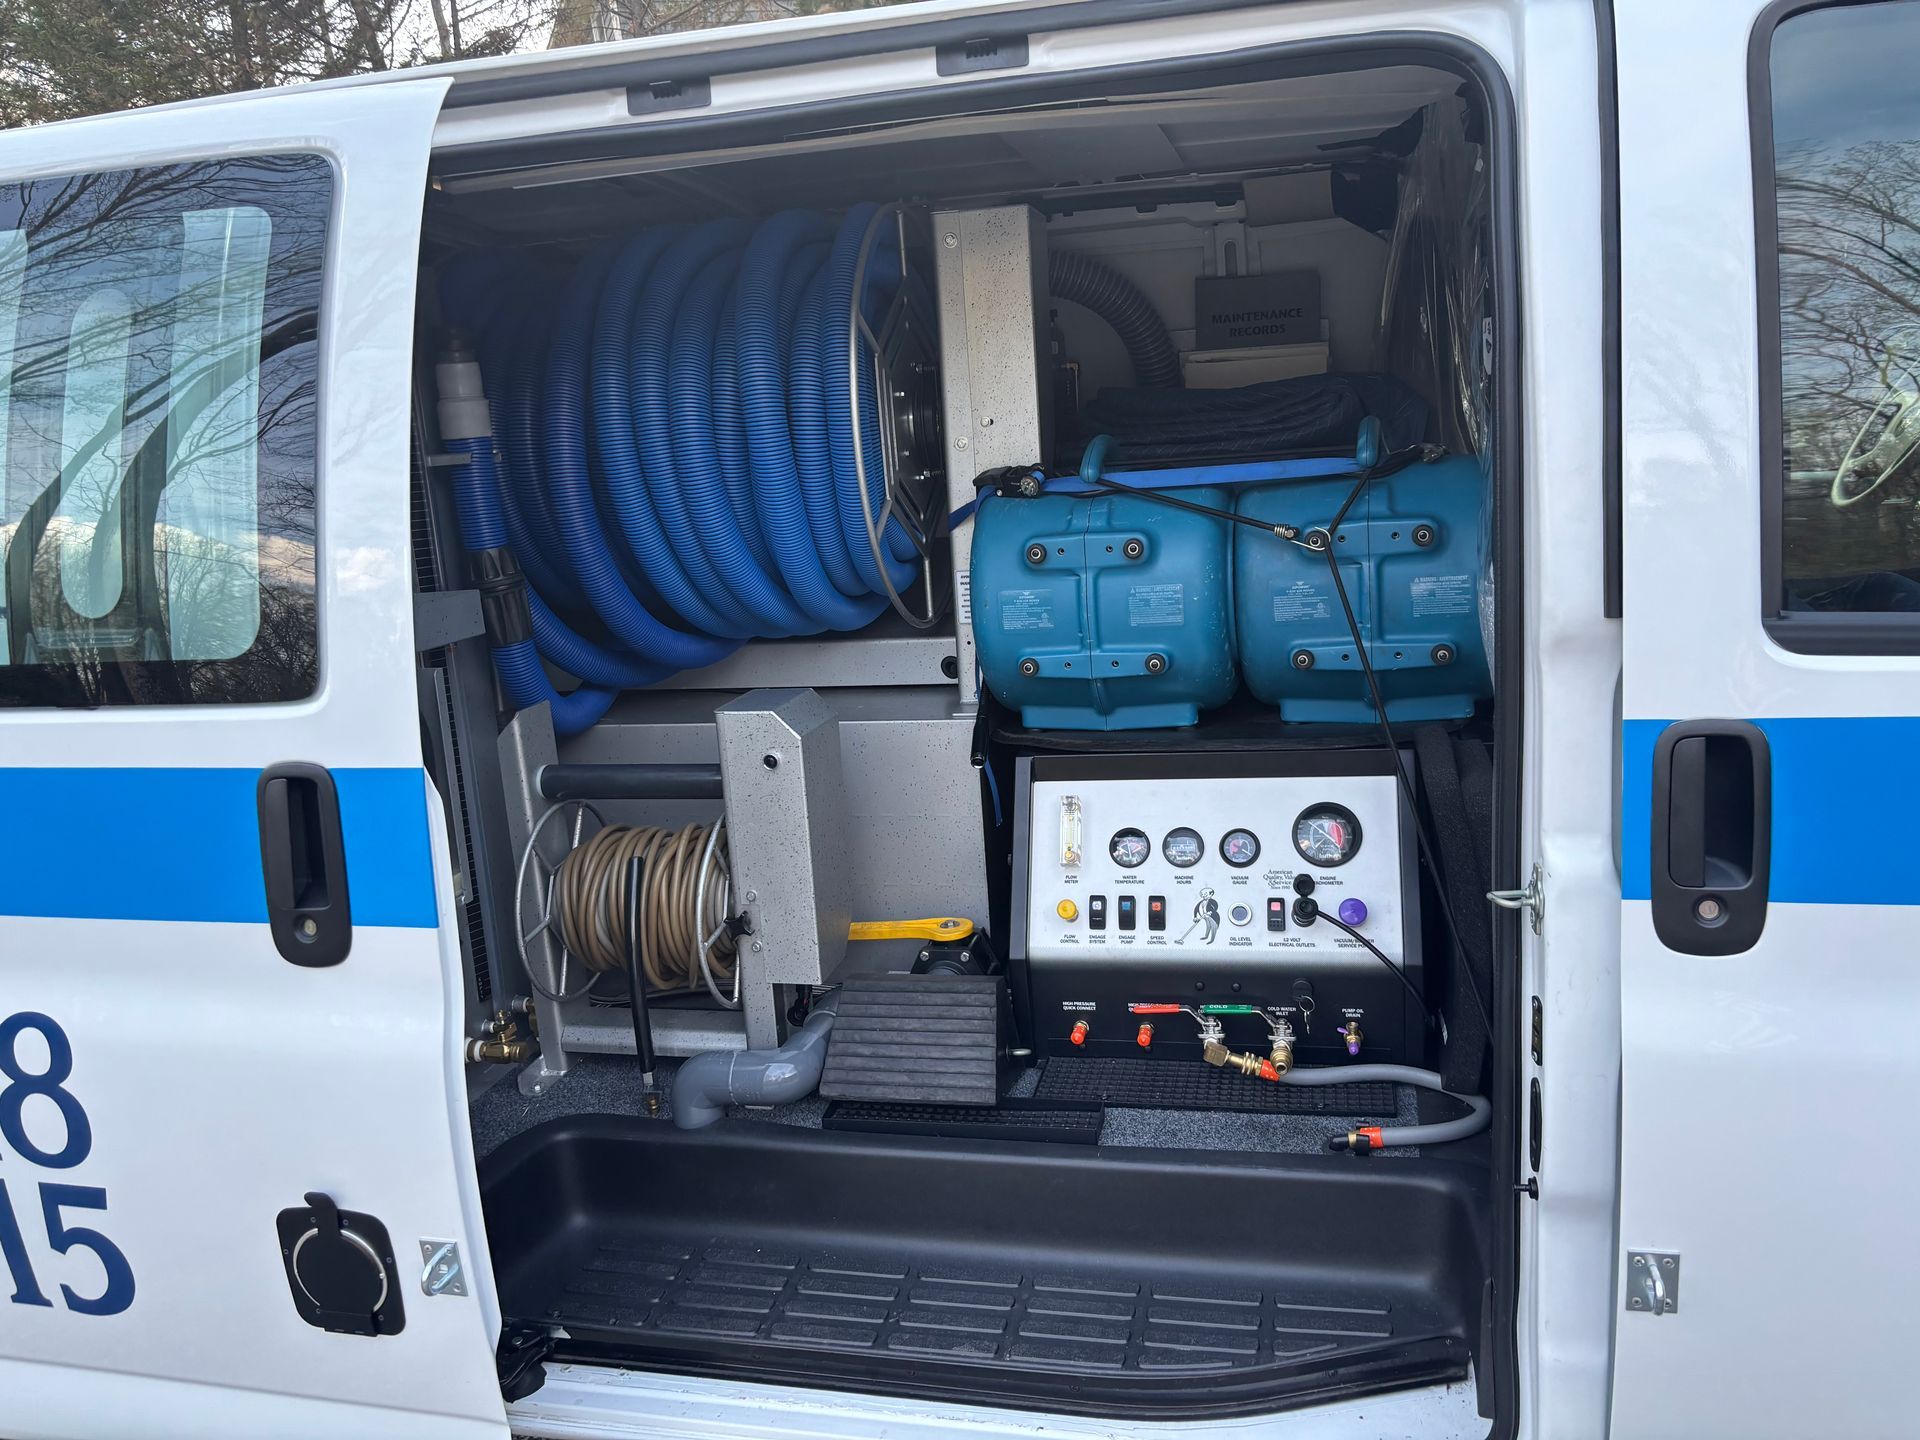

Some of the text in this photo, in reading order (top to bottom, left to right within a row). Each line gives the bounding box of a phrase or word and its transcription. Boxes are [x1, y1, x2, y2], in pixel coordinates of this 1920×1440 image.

[1211, 307, 1304, 324] MAINTENANCE
[1229, 323, 1287, 337] RECORDS
[0, 1011, 92, 1169] 8
